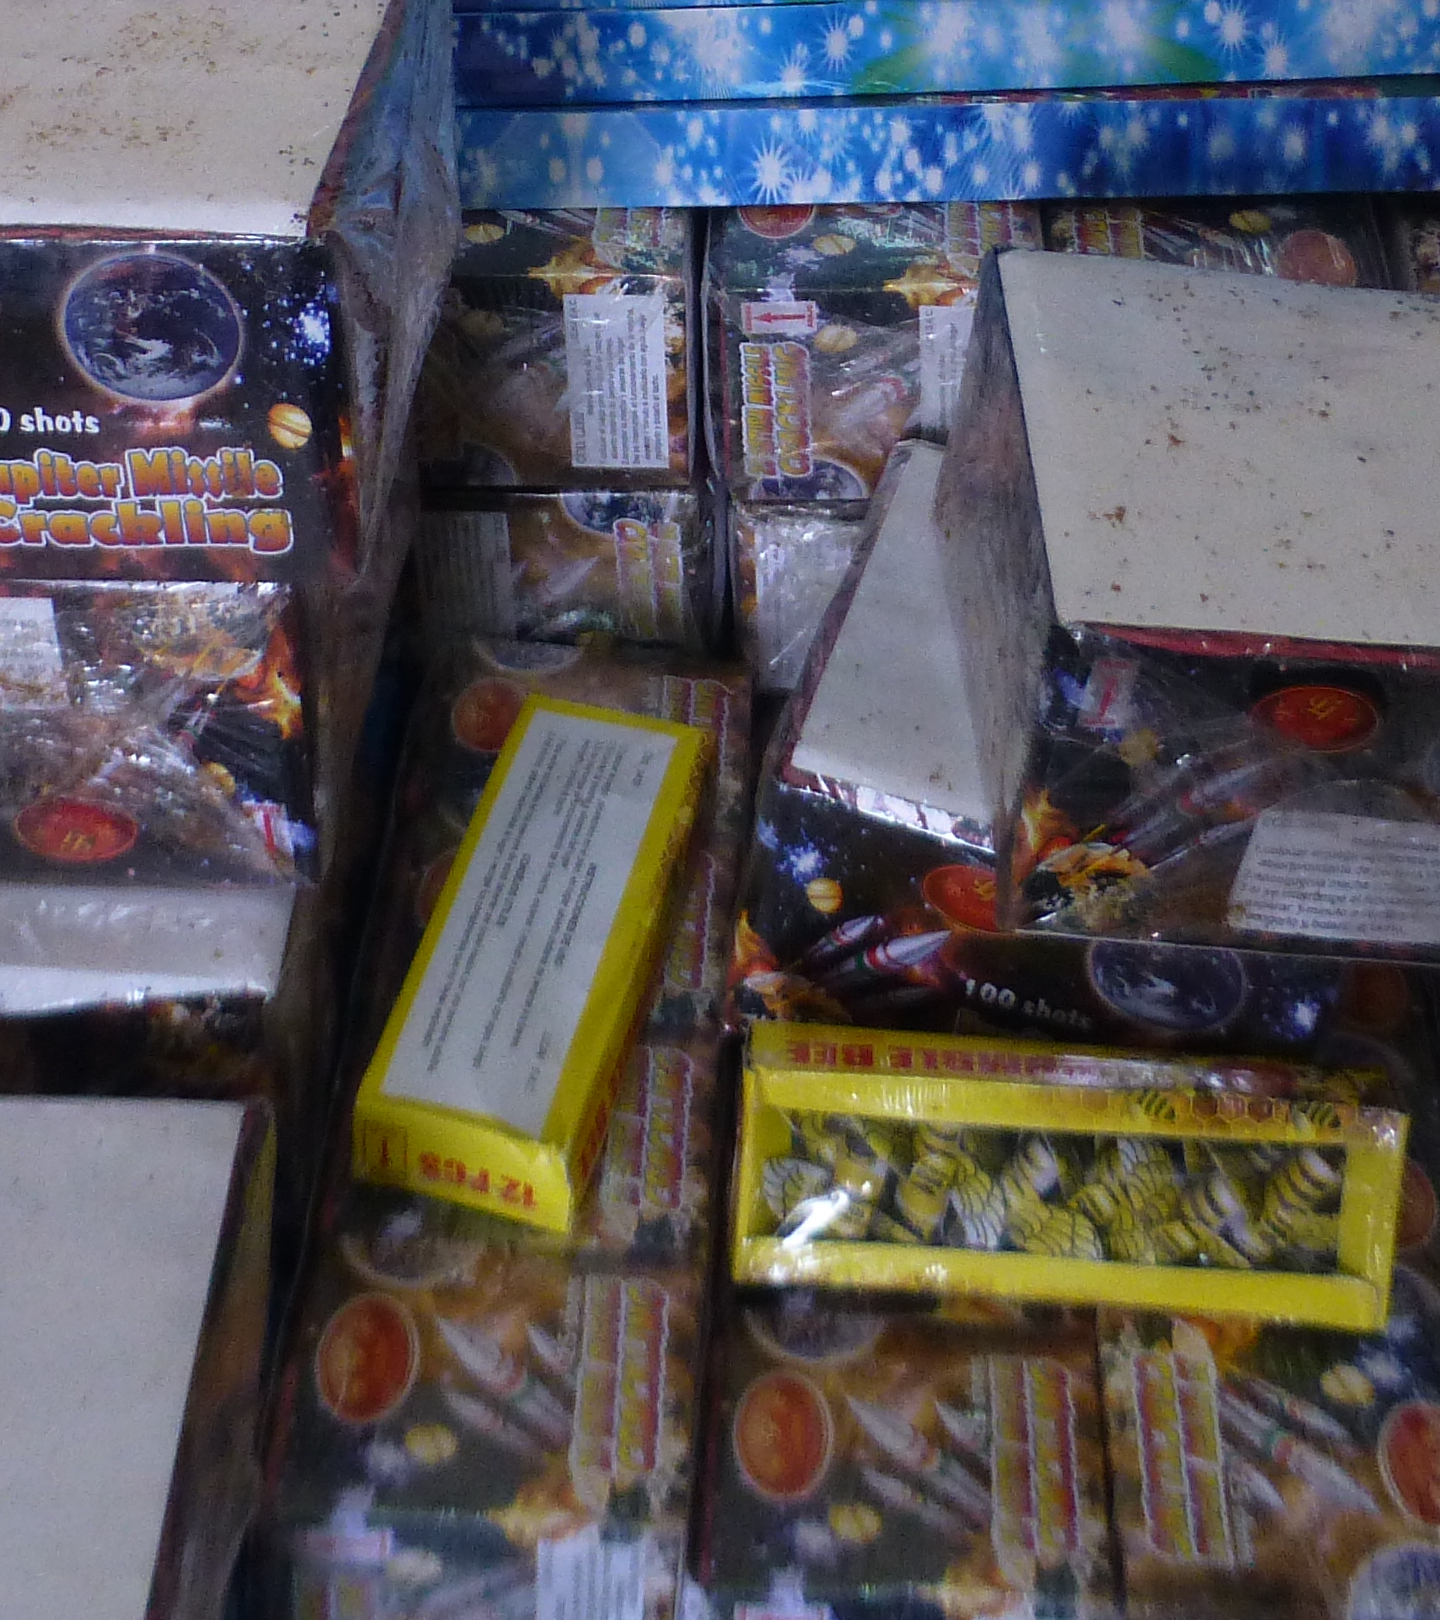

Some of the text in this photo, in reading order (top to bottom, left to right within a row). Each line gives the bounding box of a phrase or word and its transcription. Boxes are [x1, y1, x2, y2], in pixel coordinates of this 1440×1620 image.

[19, 406, 101, 436] shots
[129, 447, 284, 501] Missile
[962, 976, 1095, 1031] 100 shots
[417, 1150, 493, 1196] PCS
